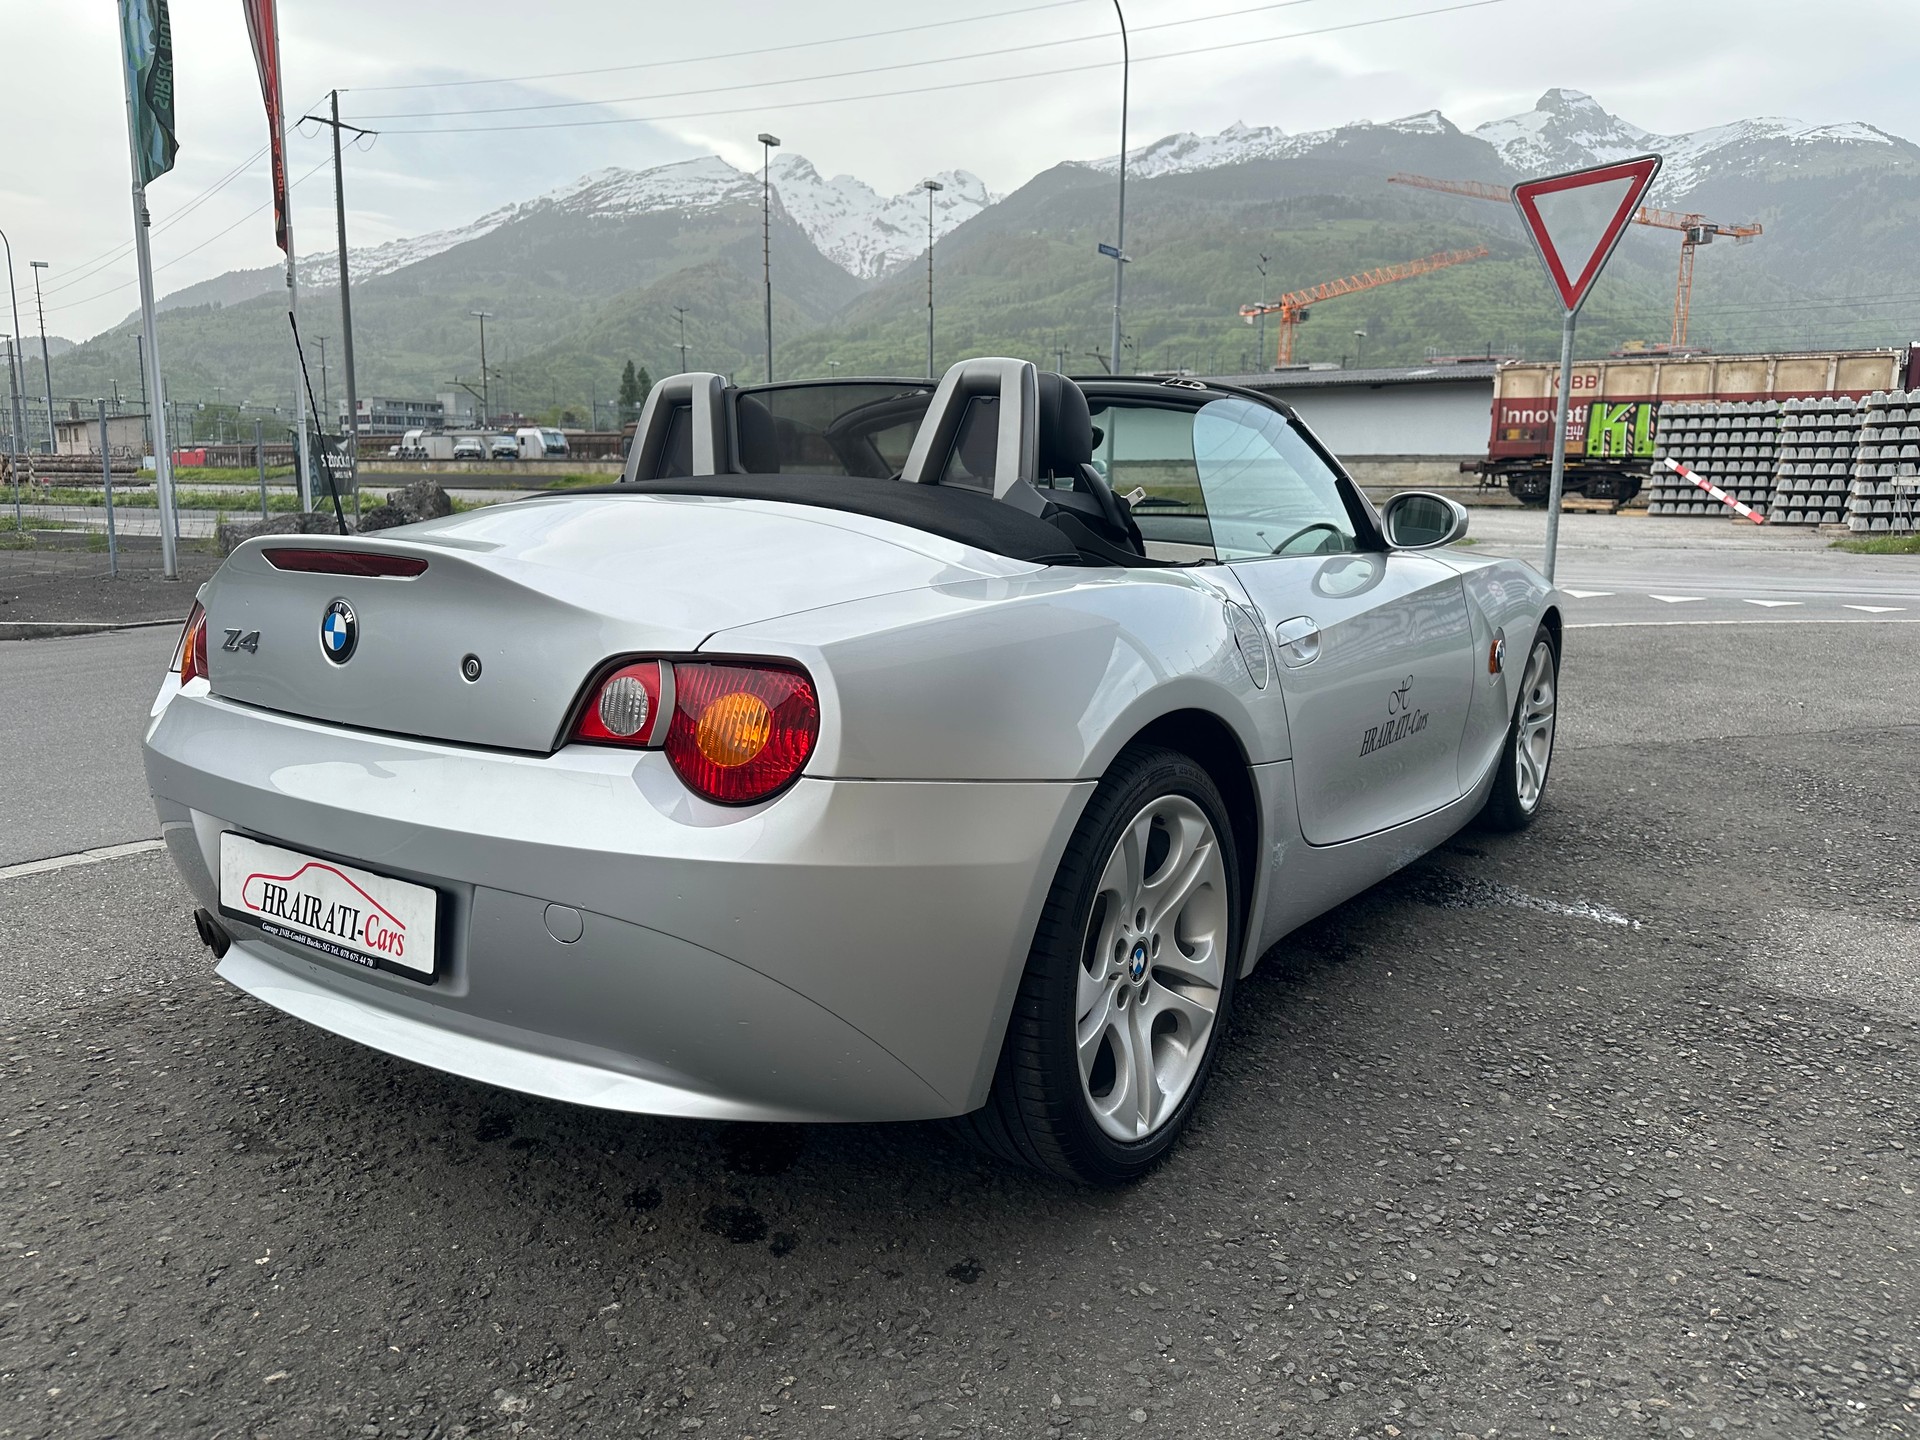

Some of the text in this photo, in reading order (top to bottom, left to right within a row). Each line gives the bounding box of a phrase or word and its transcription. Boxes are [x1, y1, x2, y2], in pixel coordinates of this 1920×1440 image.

[221, 627, 260, 655] Z4
[1359, 708, 1429, 758] HRAIRATI-Cars
[260, 881, 406, 957] HRAIRATI-Cars
[262, 922, 279, 935] Garage
[330, 945, 340, 956] Tel.
[349, 952, 360, 962] 675
[359, 955, 367, 965] 44
[366, 957, 374, 967] 70
